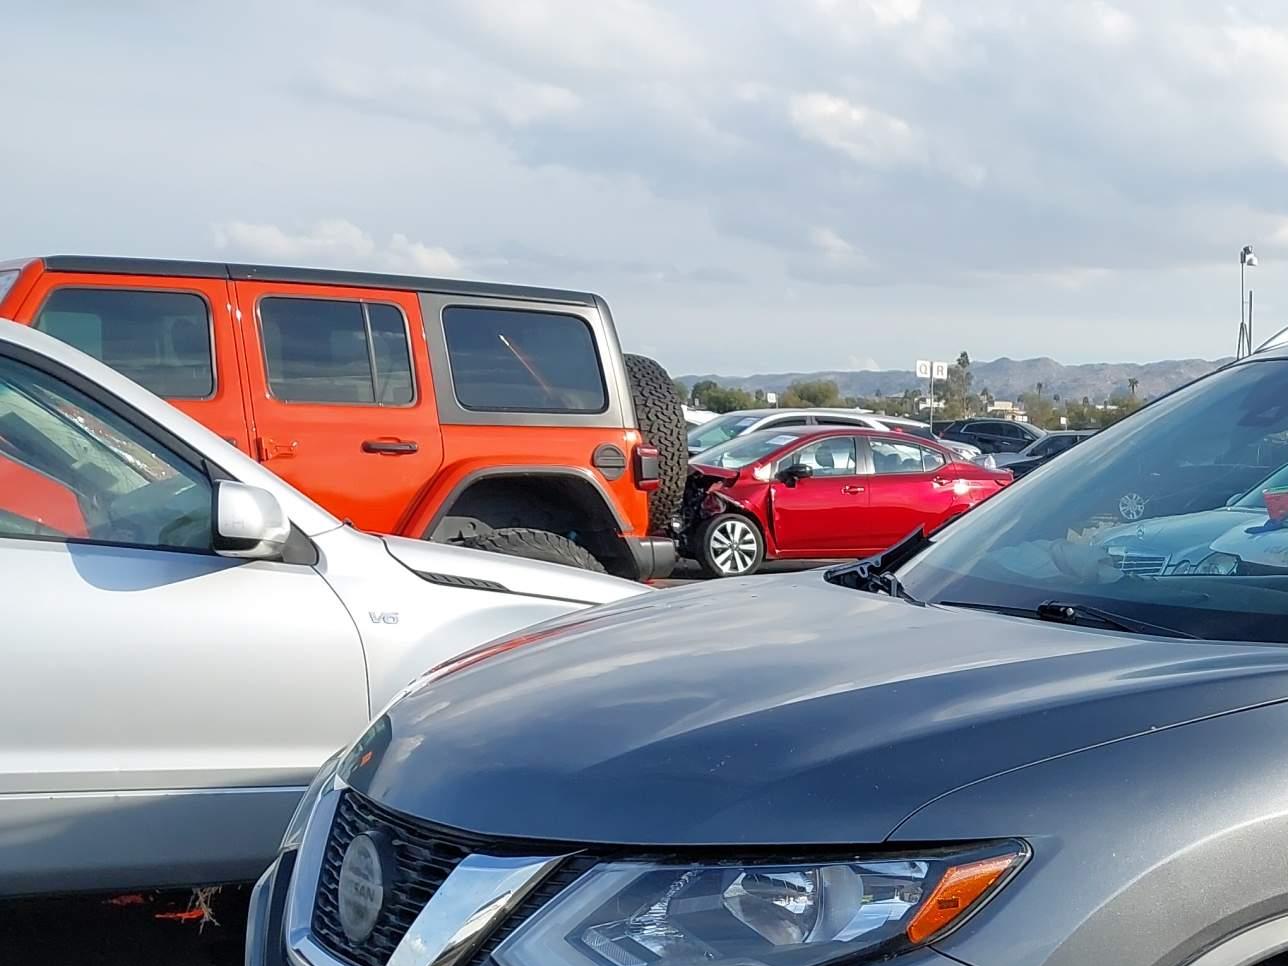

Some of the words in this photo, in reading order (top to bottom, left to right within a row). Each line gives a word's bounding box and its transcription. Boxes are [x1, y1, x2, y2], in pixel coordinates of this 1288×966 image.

[919, 363, 929, 375] Q
[936, 365, 945, 377] R
[368, 611, 399, 625] V6
